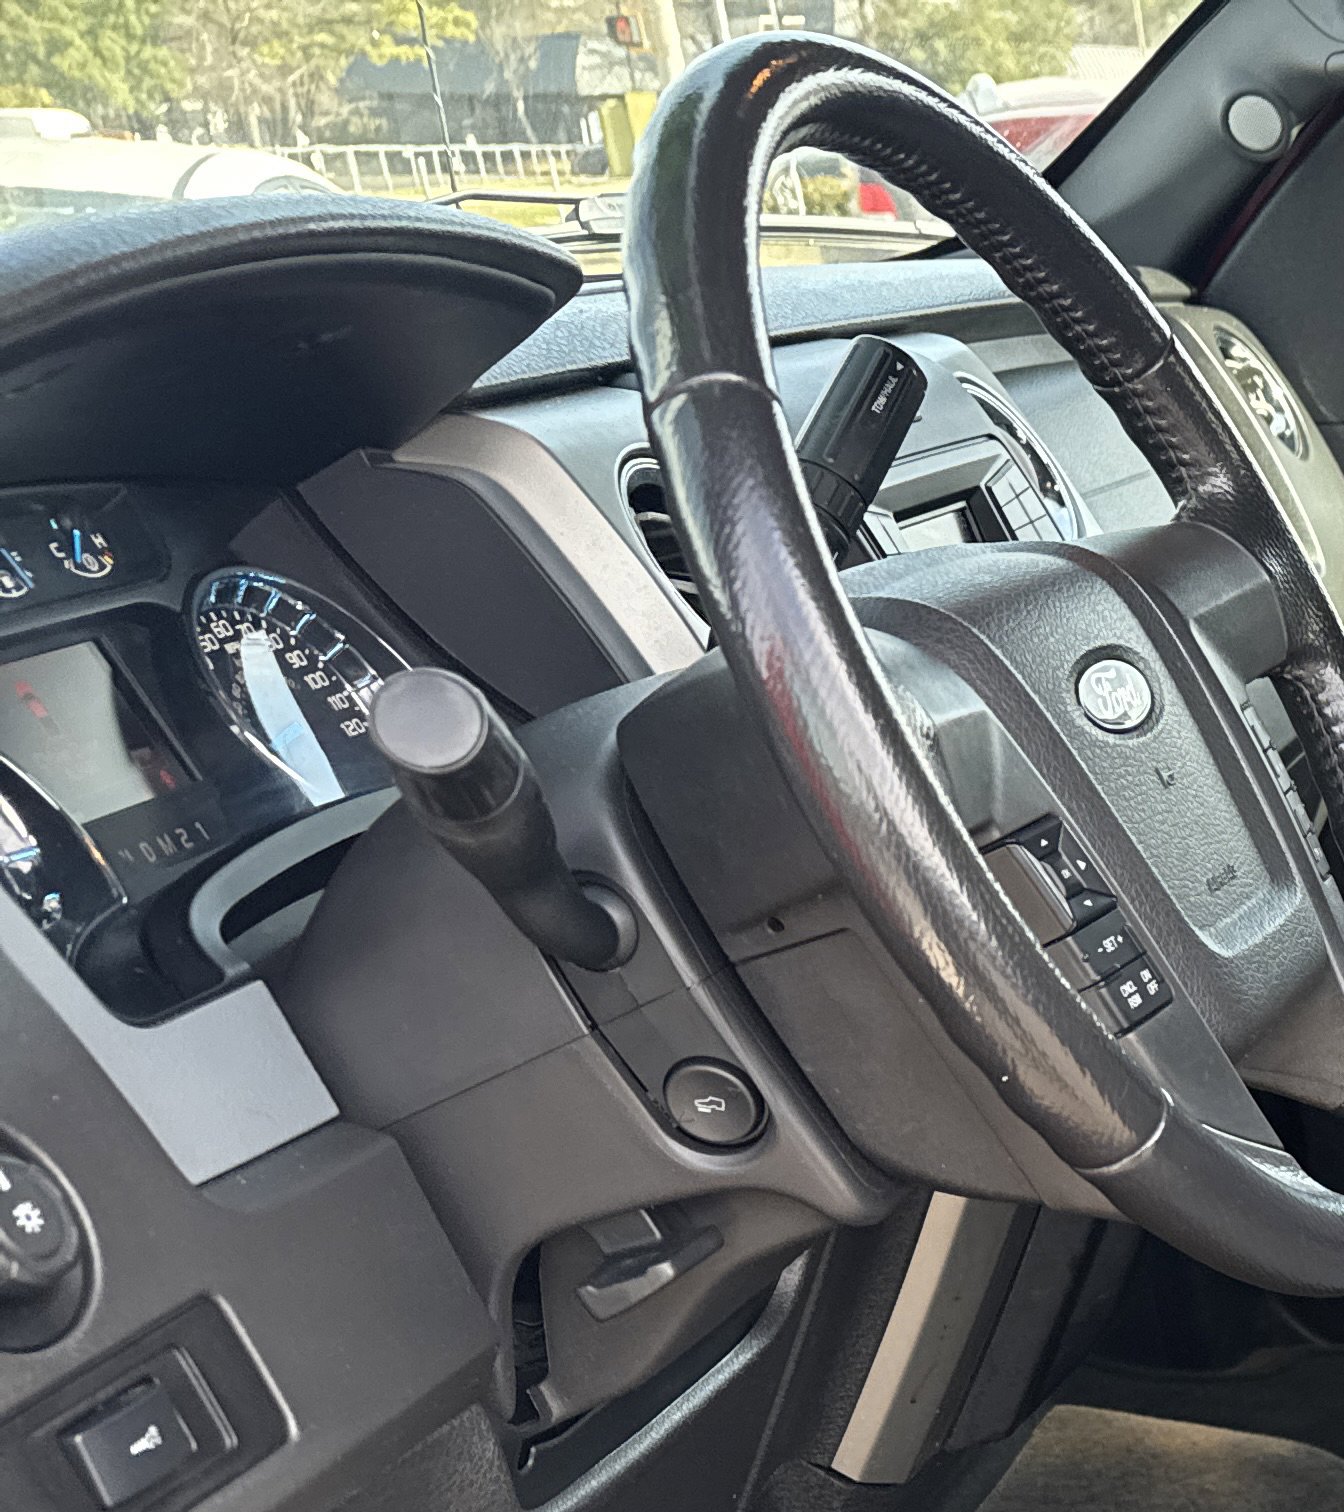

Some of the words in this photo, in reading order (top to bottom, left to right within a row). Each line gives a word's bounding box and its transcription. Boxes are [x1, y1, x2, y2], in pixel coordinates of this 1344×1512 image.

[210, 620, 234, 639] 60
[285, 649, 308, 668] 90
[304, 670, 330, 690] 100
[327, 693, 349, 711] 110
[1090, 667, 1143, 720] Ford
[340, 718, 367, 737] 120
